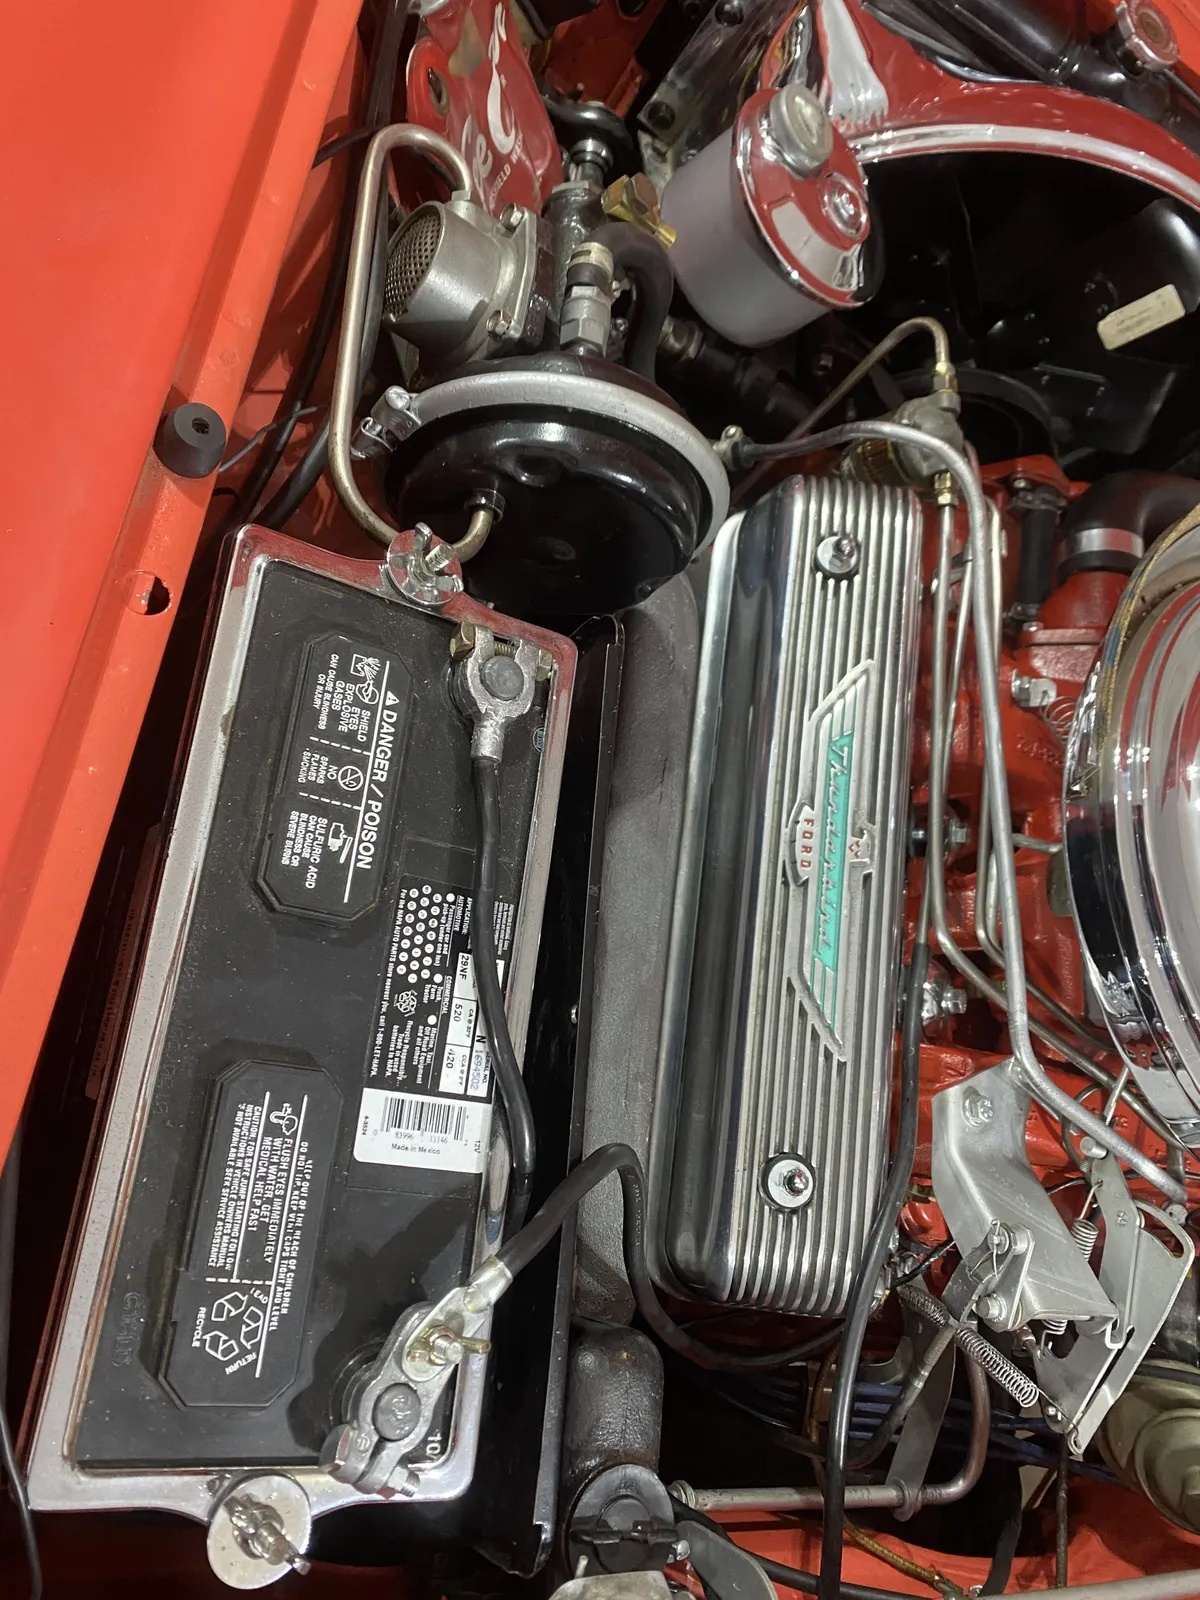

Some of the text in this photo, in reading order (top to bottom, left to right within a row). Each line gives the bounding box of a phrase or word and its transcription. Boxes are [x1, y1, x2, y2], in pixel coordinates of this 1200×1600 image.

[312, 673, 326, 709] OR INJURY
[317, 653, 339, 730] CAN CAUSE BLINDNESS
[331, 680, 345, 711] GASES
[337, 683, 355, 732] EXPLOSIVE
[348, 706, 361, 730] EYES
[356, 709, 371, 742] SHIELD
[297, 751, 311, 783] SMOKING
[307, 753, 320, 781] FLAMES
[316, 755, 328, 784] SPARKS
[326, 764, 338, 780] NO
[356, 709, 397, 869] DANGER / POISON
[281, 810, 299, 865] SEVERE BURNS
[290, 812, 308, 867] BLINDNESS OR
[301, 815, 317, 858] CAN CAUSE
[799, 818, 815, 869] FORD
[305, 817, 328, 888] SULFURIC ACID
[814, 745, 849, 956] Thunderbird
[395, 909, 404, 925] NAPA
[440, 902, 449, 923] pick-up
[445, 904, 456, 933] Passenger
[453, 895, 464, 931] AUTOMOTIVE
[392, 925, 401, 942] AUTO
[437, 924, 447, 942] (under
[389, 942, 398, 961] PARTS
[386, 962, 394, 977] store
[459, 954, 469, 980] 29NF
[383, 978, 391, 1000] nearest
[422, 983, 431, 1003] Tractor
[429, 984, 437, 999] Farm
[441, 975, 452, 1015] COMMERCIAL
[380, 1000, 389, 1014] you,
[453, 1003, 463, 1022] 520
[468, 1008, 474, 1017] CA
[389, 1024, 399, 1051] batteries
[395, 1033, 405, 1049] Trade
[403, 1020, 413, 1043] Recycle
[421, 1035, 429, 1051] Road
[475, 1035, 488, 1044] N
[391, 1057, 399, 1072] used
[412, 1046, 420, 1065] others
[384, 1059, 393, 1077] NAPA.
[416, 1052, 427, 1084] Equipment
[470, 1049, 484, 1089] 1694502
[234, 1110, 244, 1126] NOT
[361, 1115, 369, 1135] 4-3524
[226, 1127, 241, 1166] AVAILABLE
[245, 1141, 255, 1156] FOR
[299, 1141, 308, 1152] DO
[391, 1143, 409, 1151] Made
[418, 1146, 440, 1154] Mexico
[241, 1157, 252, 1176] SAFE
[296, 1154, 306, 1170] NOT
[216, 1104, 254, 1267] INSTRUCTIONS IN VEHICLE OWNERS MANUAL
[223, 1167, 233, 1186] SEEK
[238, 1177, 248, 1199] JUMP
[247, 1136, 273, 1231] MEDICAL HELP FAST
[259, 1137, 283, 1223] WITH WATER. GET
[263, 1138, 293, 1263] FLUSH EYES IMMEDIATELY
[290, 1190, 299, 1211] KEEP
[300, 1181, 309, 1197] OUT
[216, 1187, 230, 1219] SERVICE
[298, 1199, 306, 1210] OF
[231, 1200, 244, 1237] STARTING
[294, 1213, 304, 1226] THE
[207, 1220, 224, 1267] ASSISTANCE
[281, 1235, 292, 1257] CAPS
[289, 1230, 301, 1257] REACH
[277, 1259, 288, 1283] TIGHT
[287, 1259, 297, 1270] OF
[249, 1287, 268, 1304] LEAD
[273, 1286, 283, 1303] AND
[279, 1272, 294, 1314] CHILDREN
[191, 1306, 206, 1347] RECYCLE
[268, 1305, 280, 1330] LEVEL
[224, 1350, 257, 1375] RETURN
